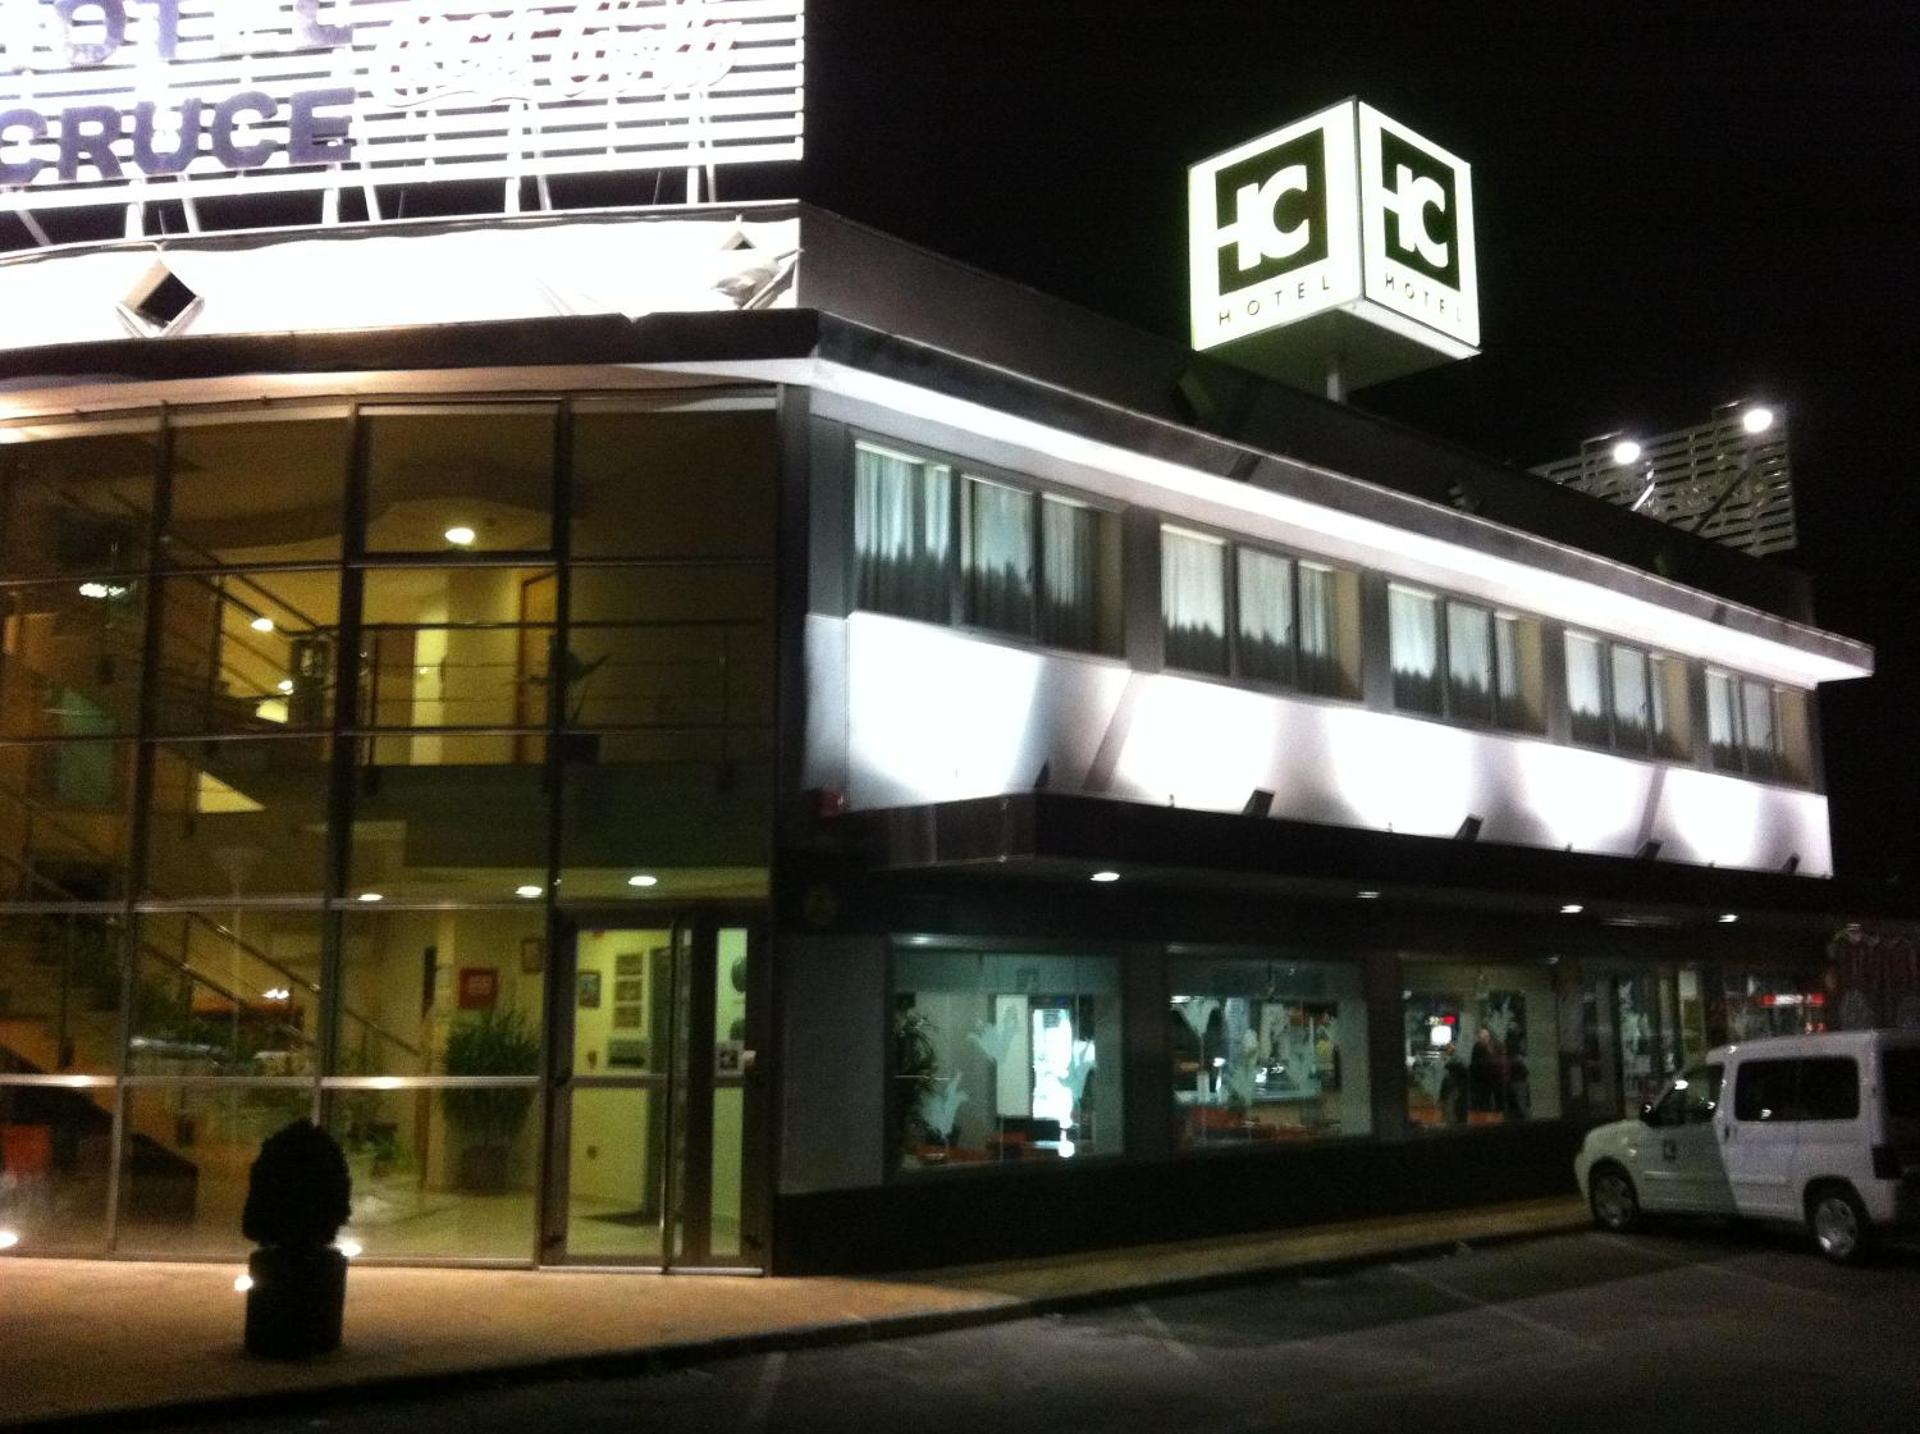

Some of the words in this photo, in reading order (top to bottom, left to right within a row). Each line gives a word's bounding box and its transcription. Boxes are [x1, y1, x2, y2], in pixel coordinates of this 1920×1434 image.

[0, 87, 357, 185] CRUCE
[1218, 274, 1331, 327] HOTEL
[1384, 272, 1463, 323] HOTEL
